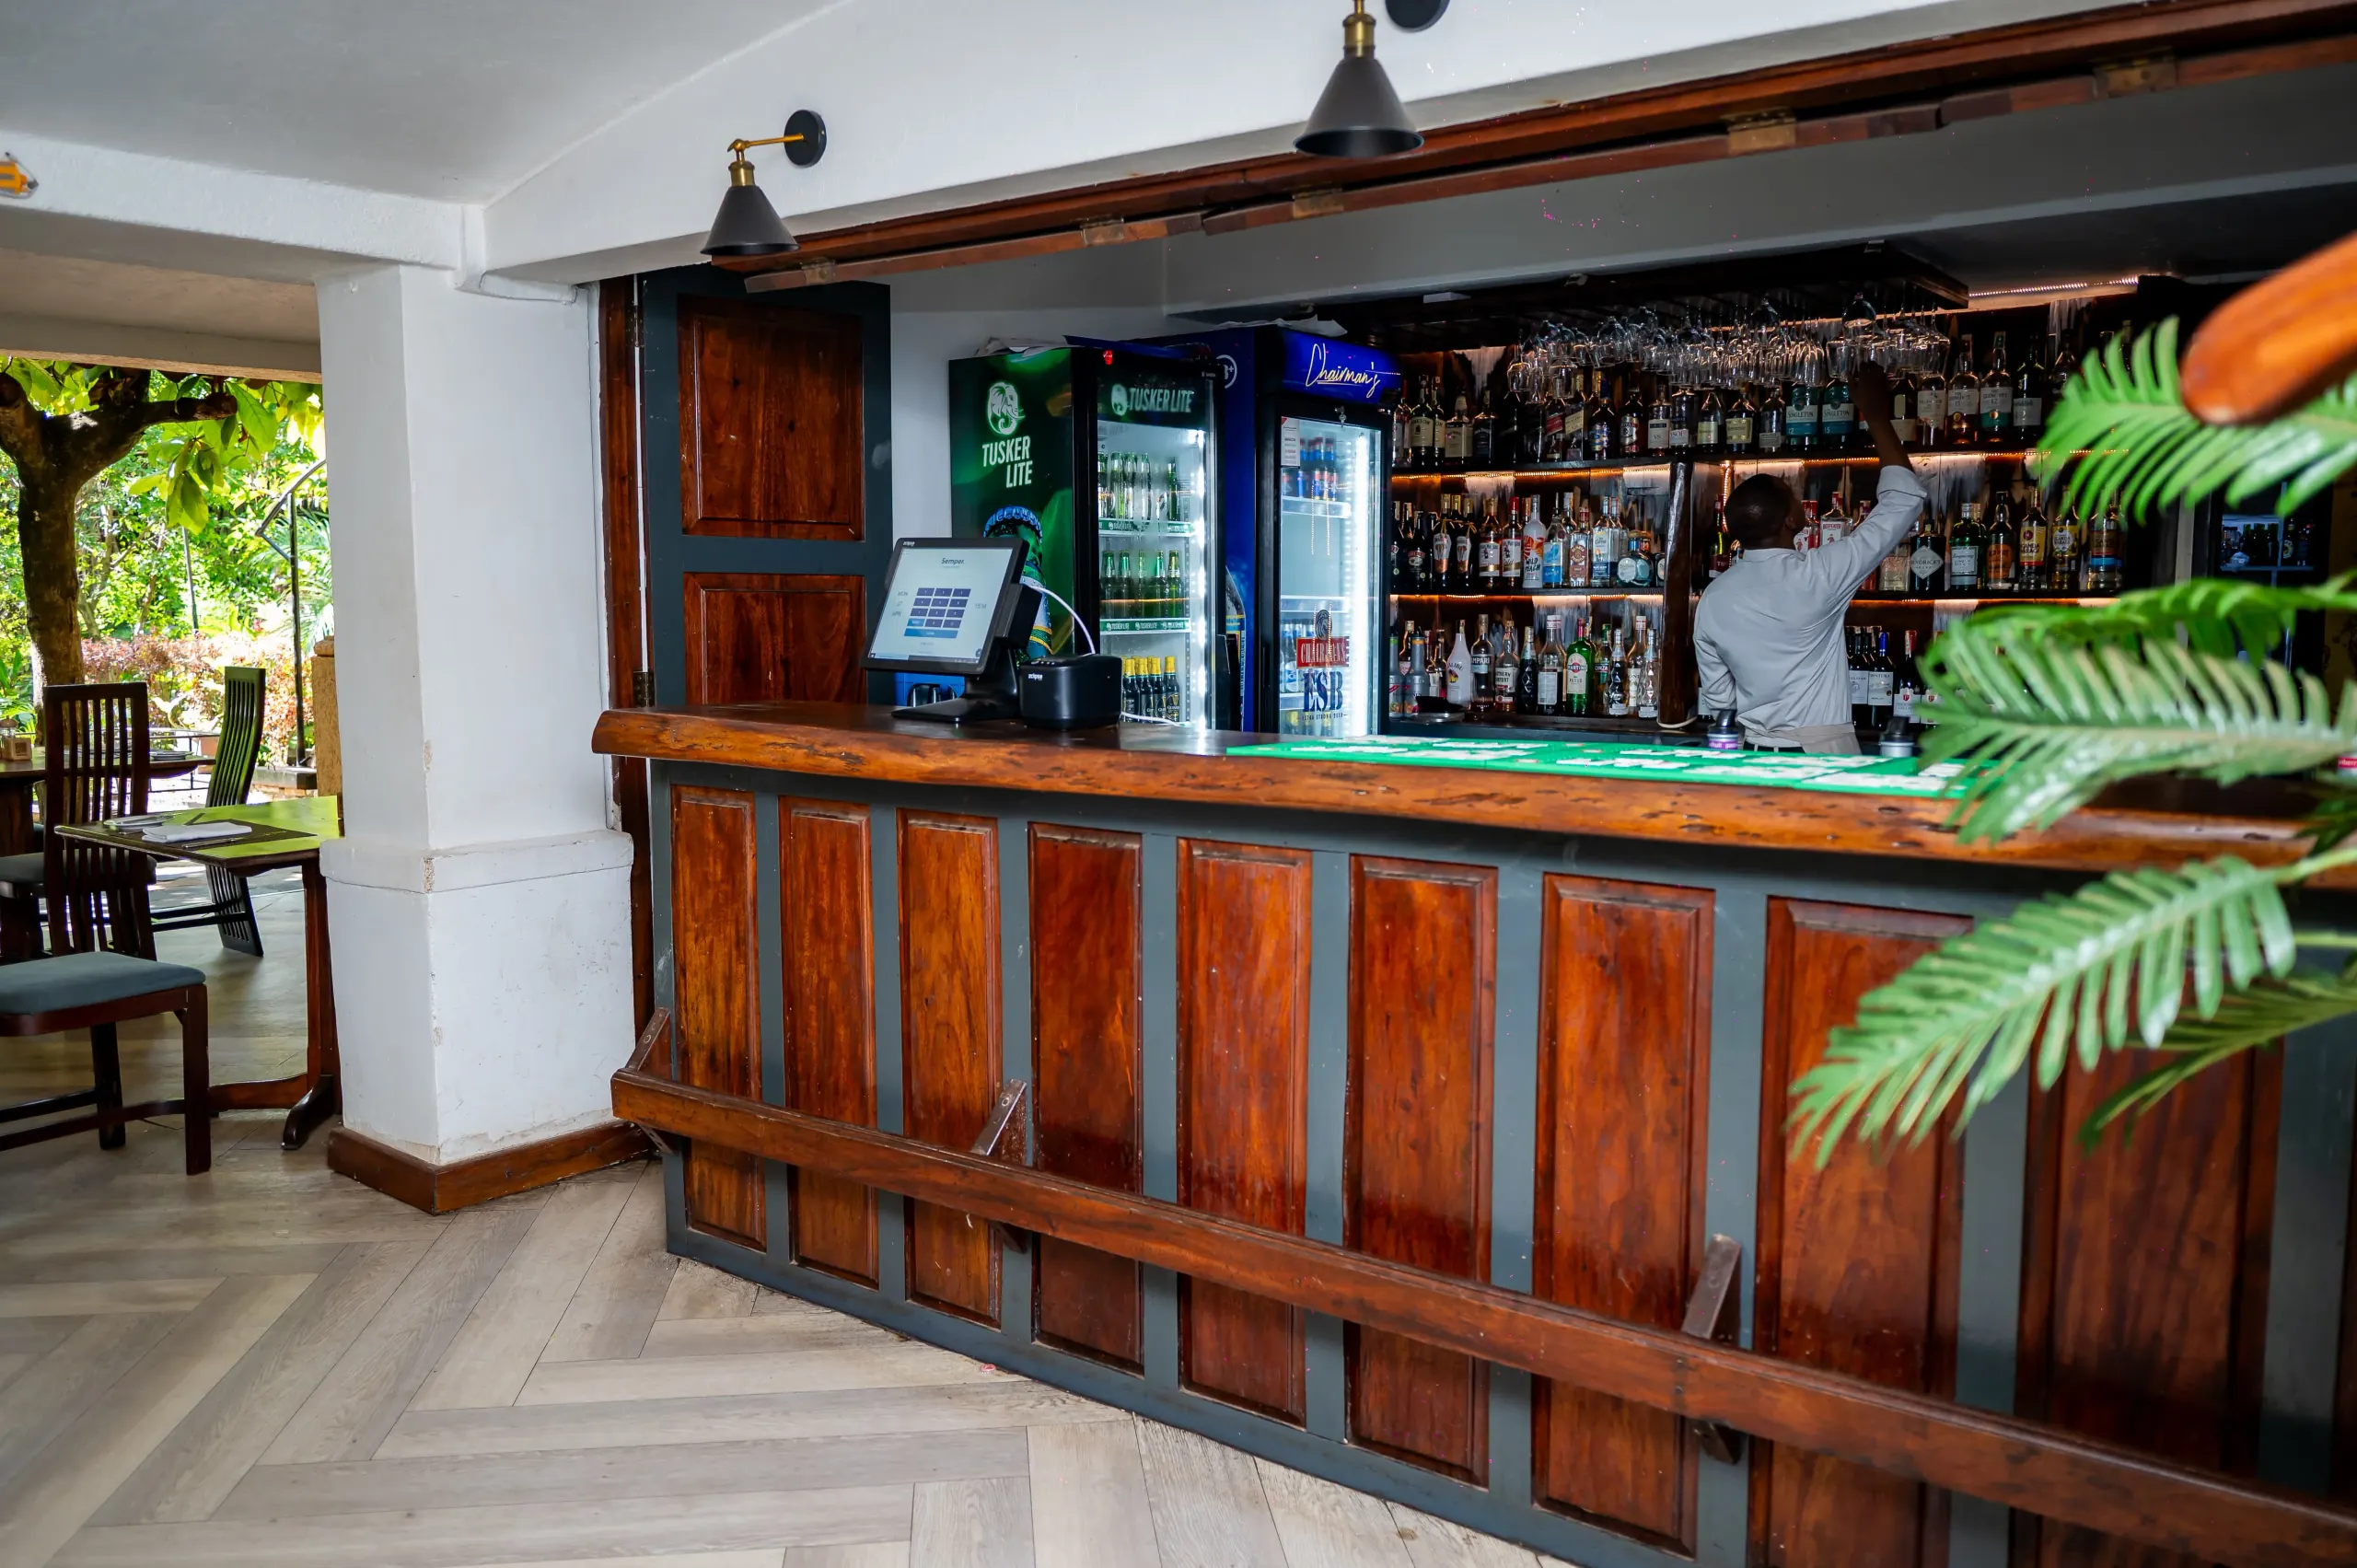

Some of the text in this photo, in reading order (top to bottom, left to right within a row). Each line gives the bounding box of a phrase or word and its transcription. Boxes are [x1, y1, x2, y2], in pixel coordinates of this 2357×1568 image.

[1305, 343, 1380, 399] Chairman's
[1129, 387, 1195, 412] TUSKER LITE
[981, 436, 1031, 467] TUSKER
[1005, 460, 1033, 488] LITE
[941, 557, 965, 565] Semper.
[1447, 662, 1465, 671] ALIBU
[1303, 670, 1343, 713] ESB
